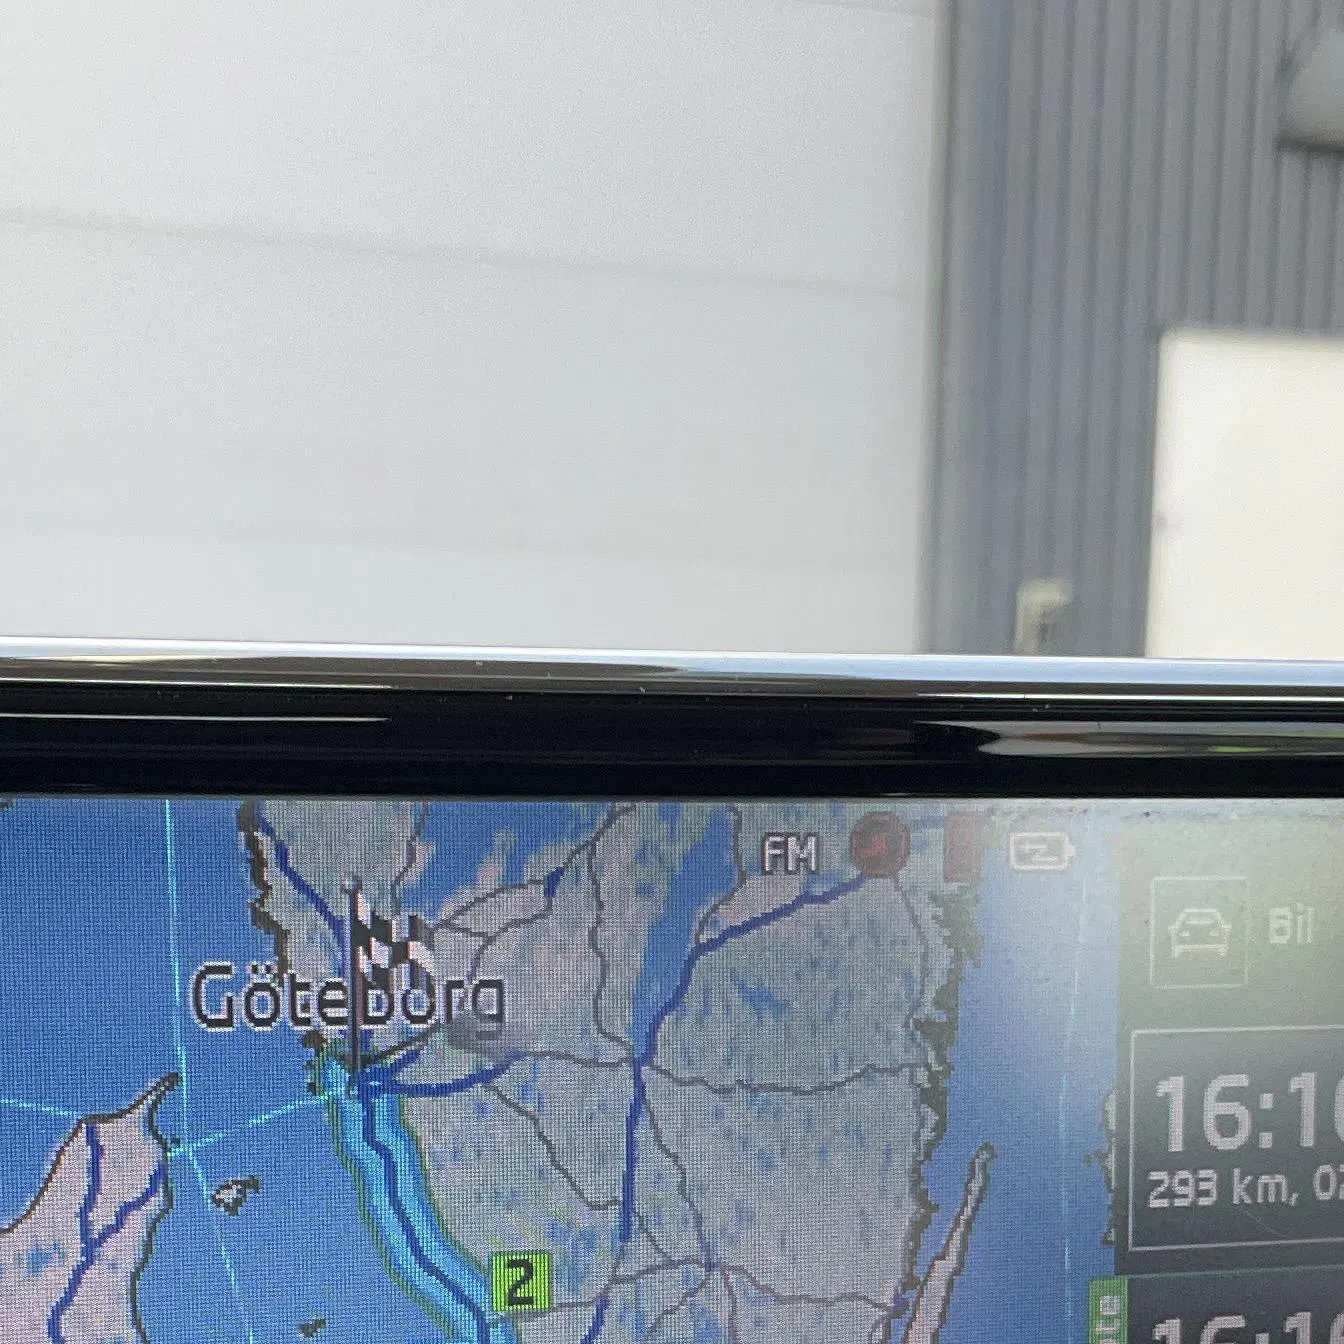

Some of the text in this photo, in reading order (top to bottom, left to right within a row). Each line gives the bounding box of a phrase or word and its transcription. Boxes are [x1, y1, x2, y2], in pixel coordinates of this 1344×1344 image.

[763, 834, 819, 873] FM
[1268, 903, 1315, 945] Bil
[191, 962, 505, 1040] Göteborg
[1147, 1169, 1218, 1208] 293
[1232, 1168, 1299, 1206] km,
[505, 1259, 534, 1307] 2
